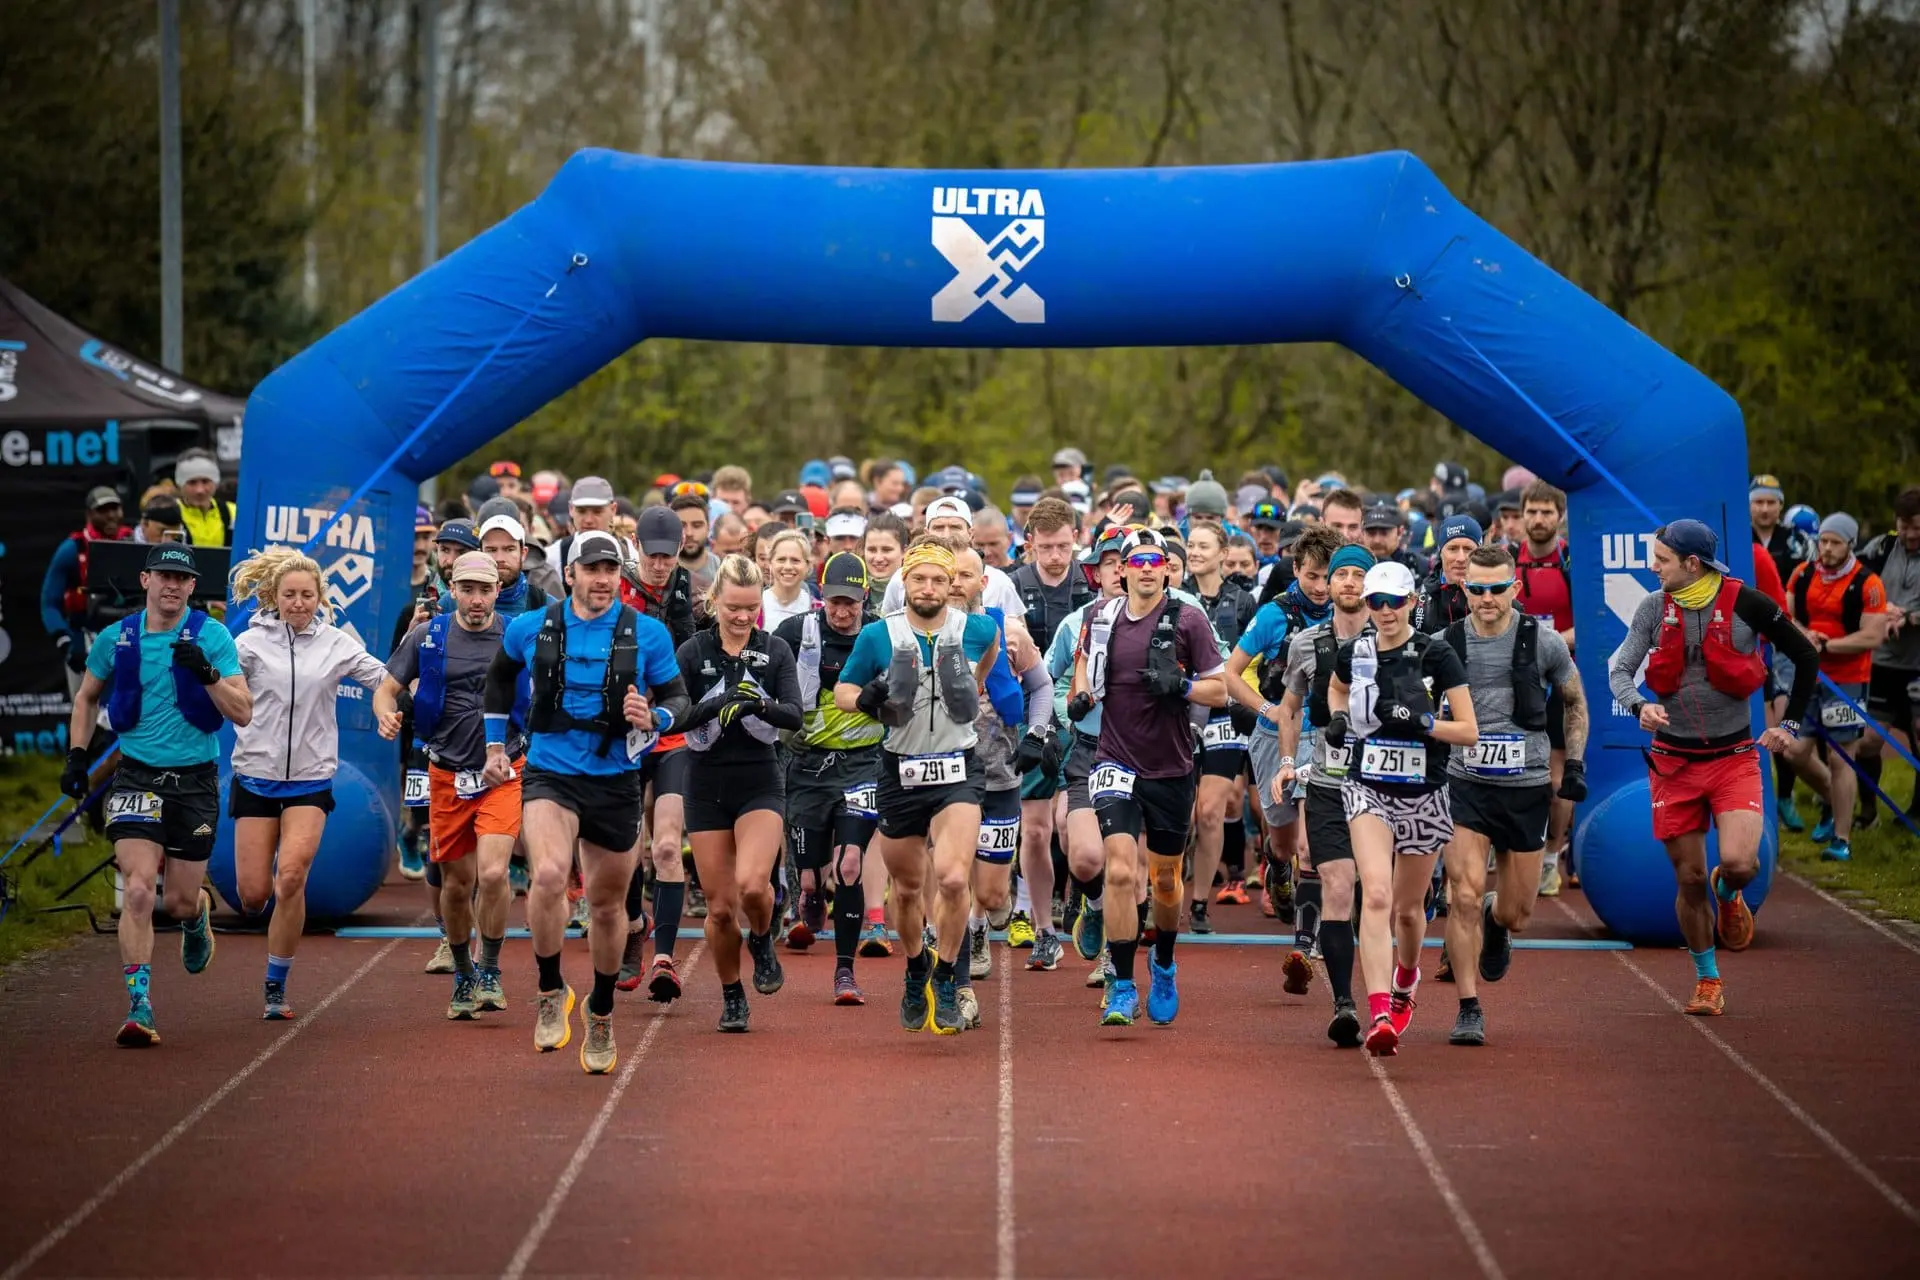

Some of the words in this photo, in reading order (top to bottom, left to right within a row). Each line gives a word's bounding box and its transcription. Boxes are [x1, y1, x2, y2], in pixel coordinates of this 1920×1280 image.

[932, 187, 1045, 216] ULTRA
[265, 505, 376, 554] ULTRA
[161, 550, 190, 564] HOKA
[539, 633, 552, 643] VIA
[1835, 706, 1857, 723] 590
[1379, 748, 1404, 772] 251
[1480, 744, 1507, 764] 274
[920, 760, 945, 782] 291
[1096, 769, 1116, 790] 145
[406, 777, 423, 797] 215
[118, 794, 143, 813] 241
[993, 827, 1015, 848] 282
